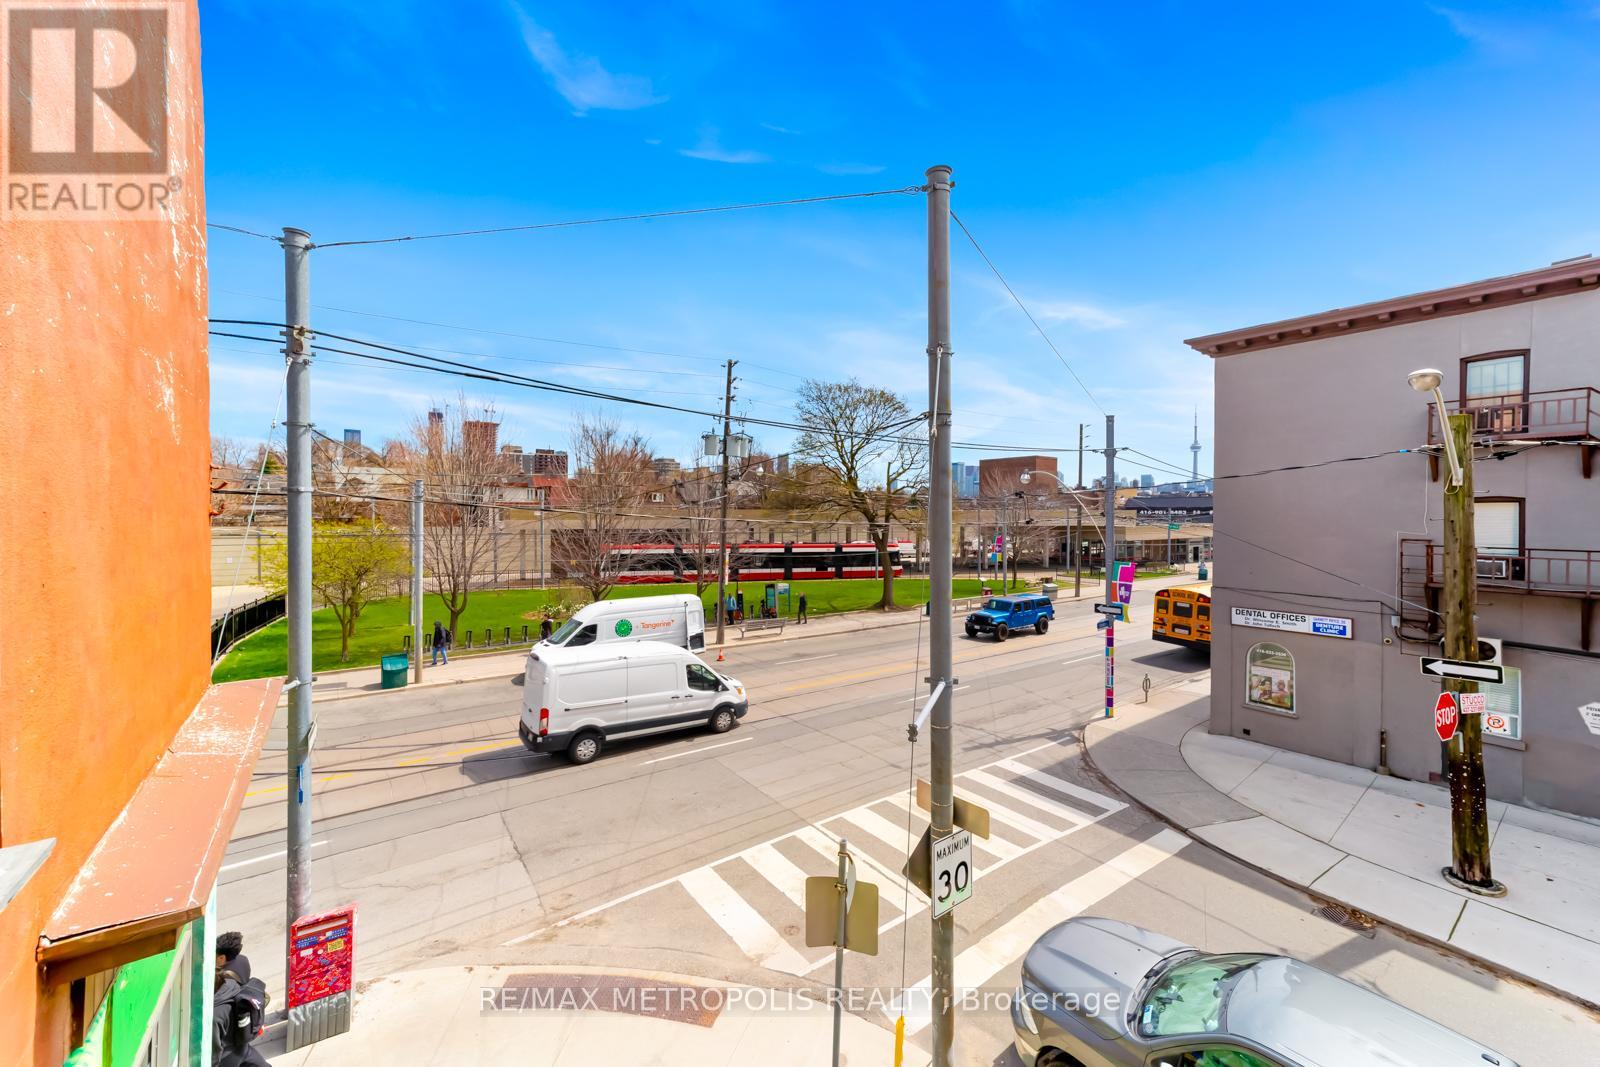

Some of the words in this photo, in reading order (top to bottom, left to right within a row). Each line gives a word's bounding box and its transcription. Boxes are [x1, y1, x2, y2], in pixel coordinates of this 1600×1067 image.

[640, 620, 672, 629] Tangerine
[1235, 609, 1267, 619] DENTAL
[1270, 612, 1307, 623] OFFICES
[1315, 623, 1344, 631] DENTURE
[1436, 706, 1456, 727] STOP
[936, 835, 970, 861] MAXIMUM
[938, 860, 969, 903] 30
